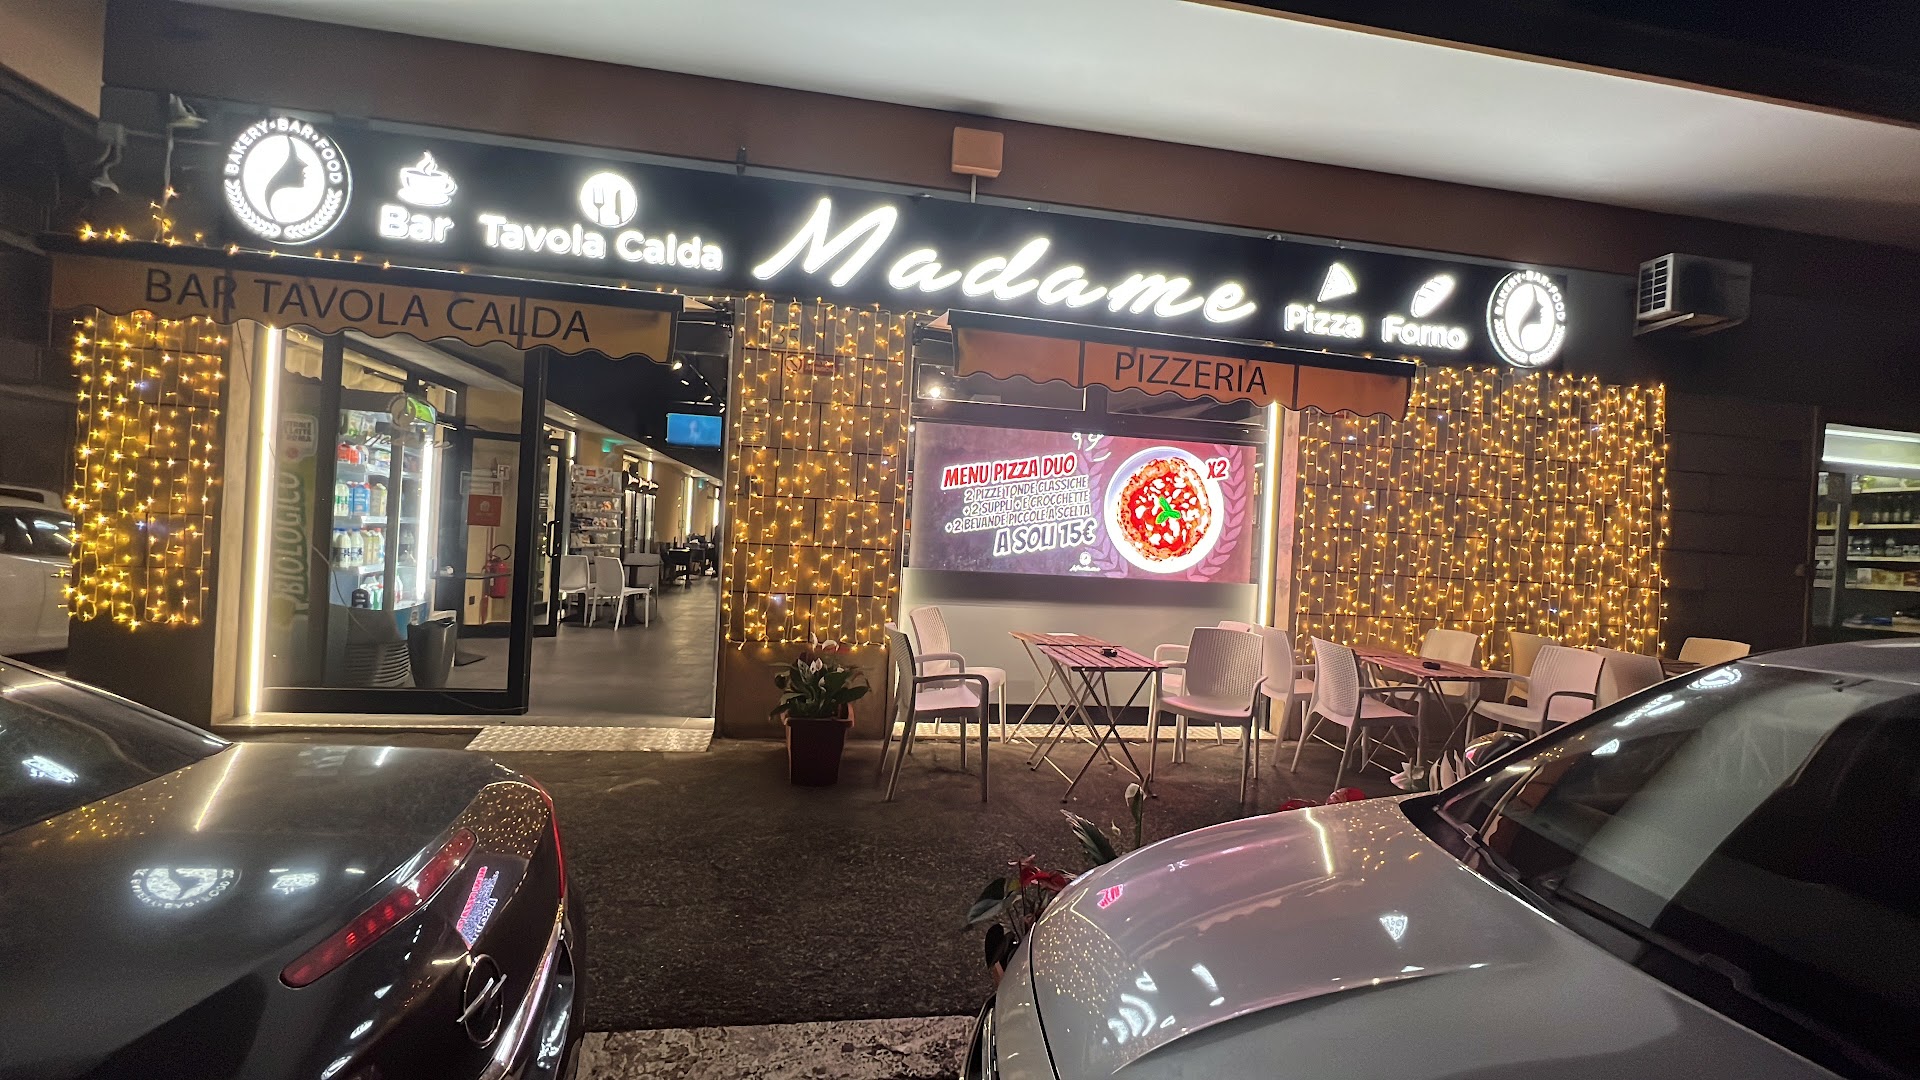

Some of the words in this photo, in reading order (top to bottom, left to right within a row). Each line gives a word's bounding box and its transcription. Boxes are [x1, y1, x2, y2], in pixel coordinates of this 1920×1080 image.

[224, 118, 268, 176] BAKERY
[277, 117, 313, 139] BAR
[315, 138, 343, 184] FOOD
[379, 204, 454, 243] Bar
[478, 213, 606, 259] Tavola
[616, 230, 724, 271] Calda
[752, 197, 1258, 323] Madame
[145, 267, 238, 309] BAR
[254, 278, 429, 328] TAVOLA
[446, 297, 590, 343] CALDA
[1284, 303, 1364, 339] Pizza
[1548, 285, 1566, 321] FOOD
[1381, 315, 1467, 350] Forno
[1115, 351, 1267, 395] PIZZERIA
[943, 464, 989, 488] MENU
[993, 458, 1038, 481] PIZZA
[1043, 454, 1076, 477] DUO
[965, 489, 973, 501] 2
[975, 486, 1002, 500] PIZZE
[1005, 482, 1036, 498] TONDE
[1038, 476, 1087, 493] CLASSICHE
[964, 513, 1006, 531] BEVANDE
[1008, 508, 1046, 525] PICCOLE
[1057, 503, 1090, 520] SCELTA
[1030, 490, 1089, 508] CROCCHETTE
[274, 471, 305, 595] BIOLOGICO
[995, 530, 1010, 554] A
[1013, 525, 1056, 552] SOLI
[1060, 519, 1095, 546] 15€
